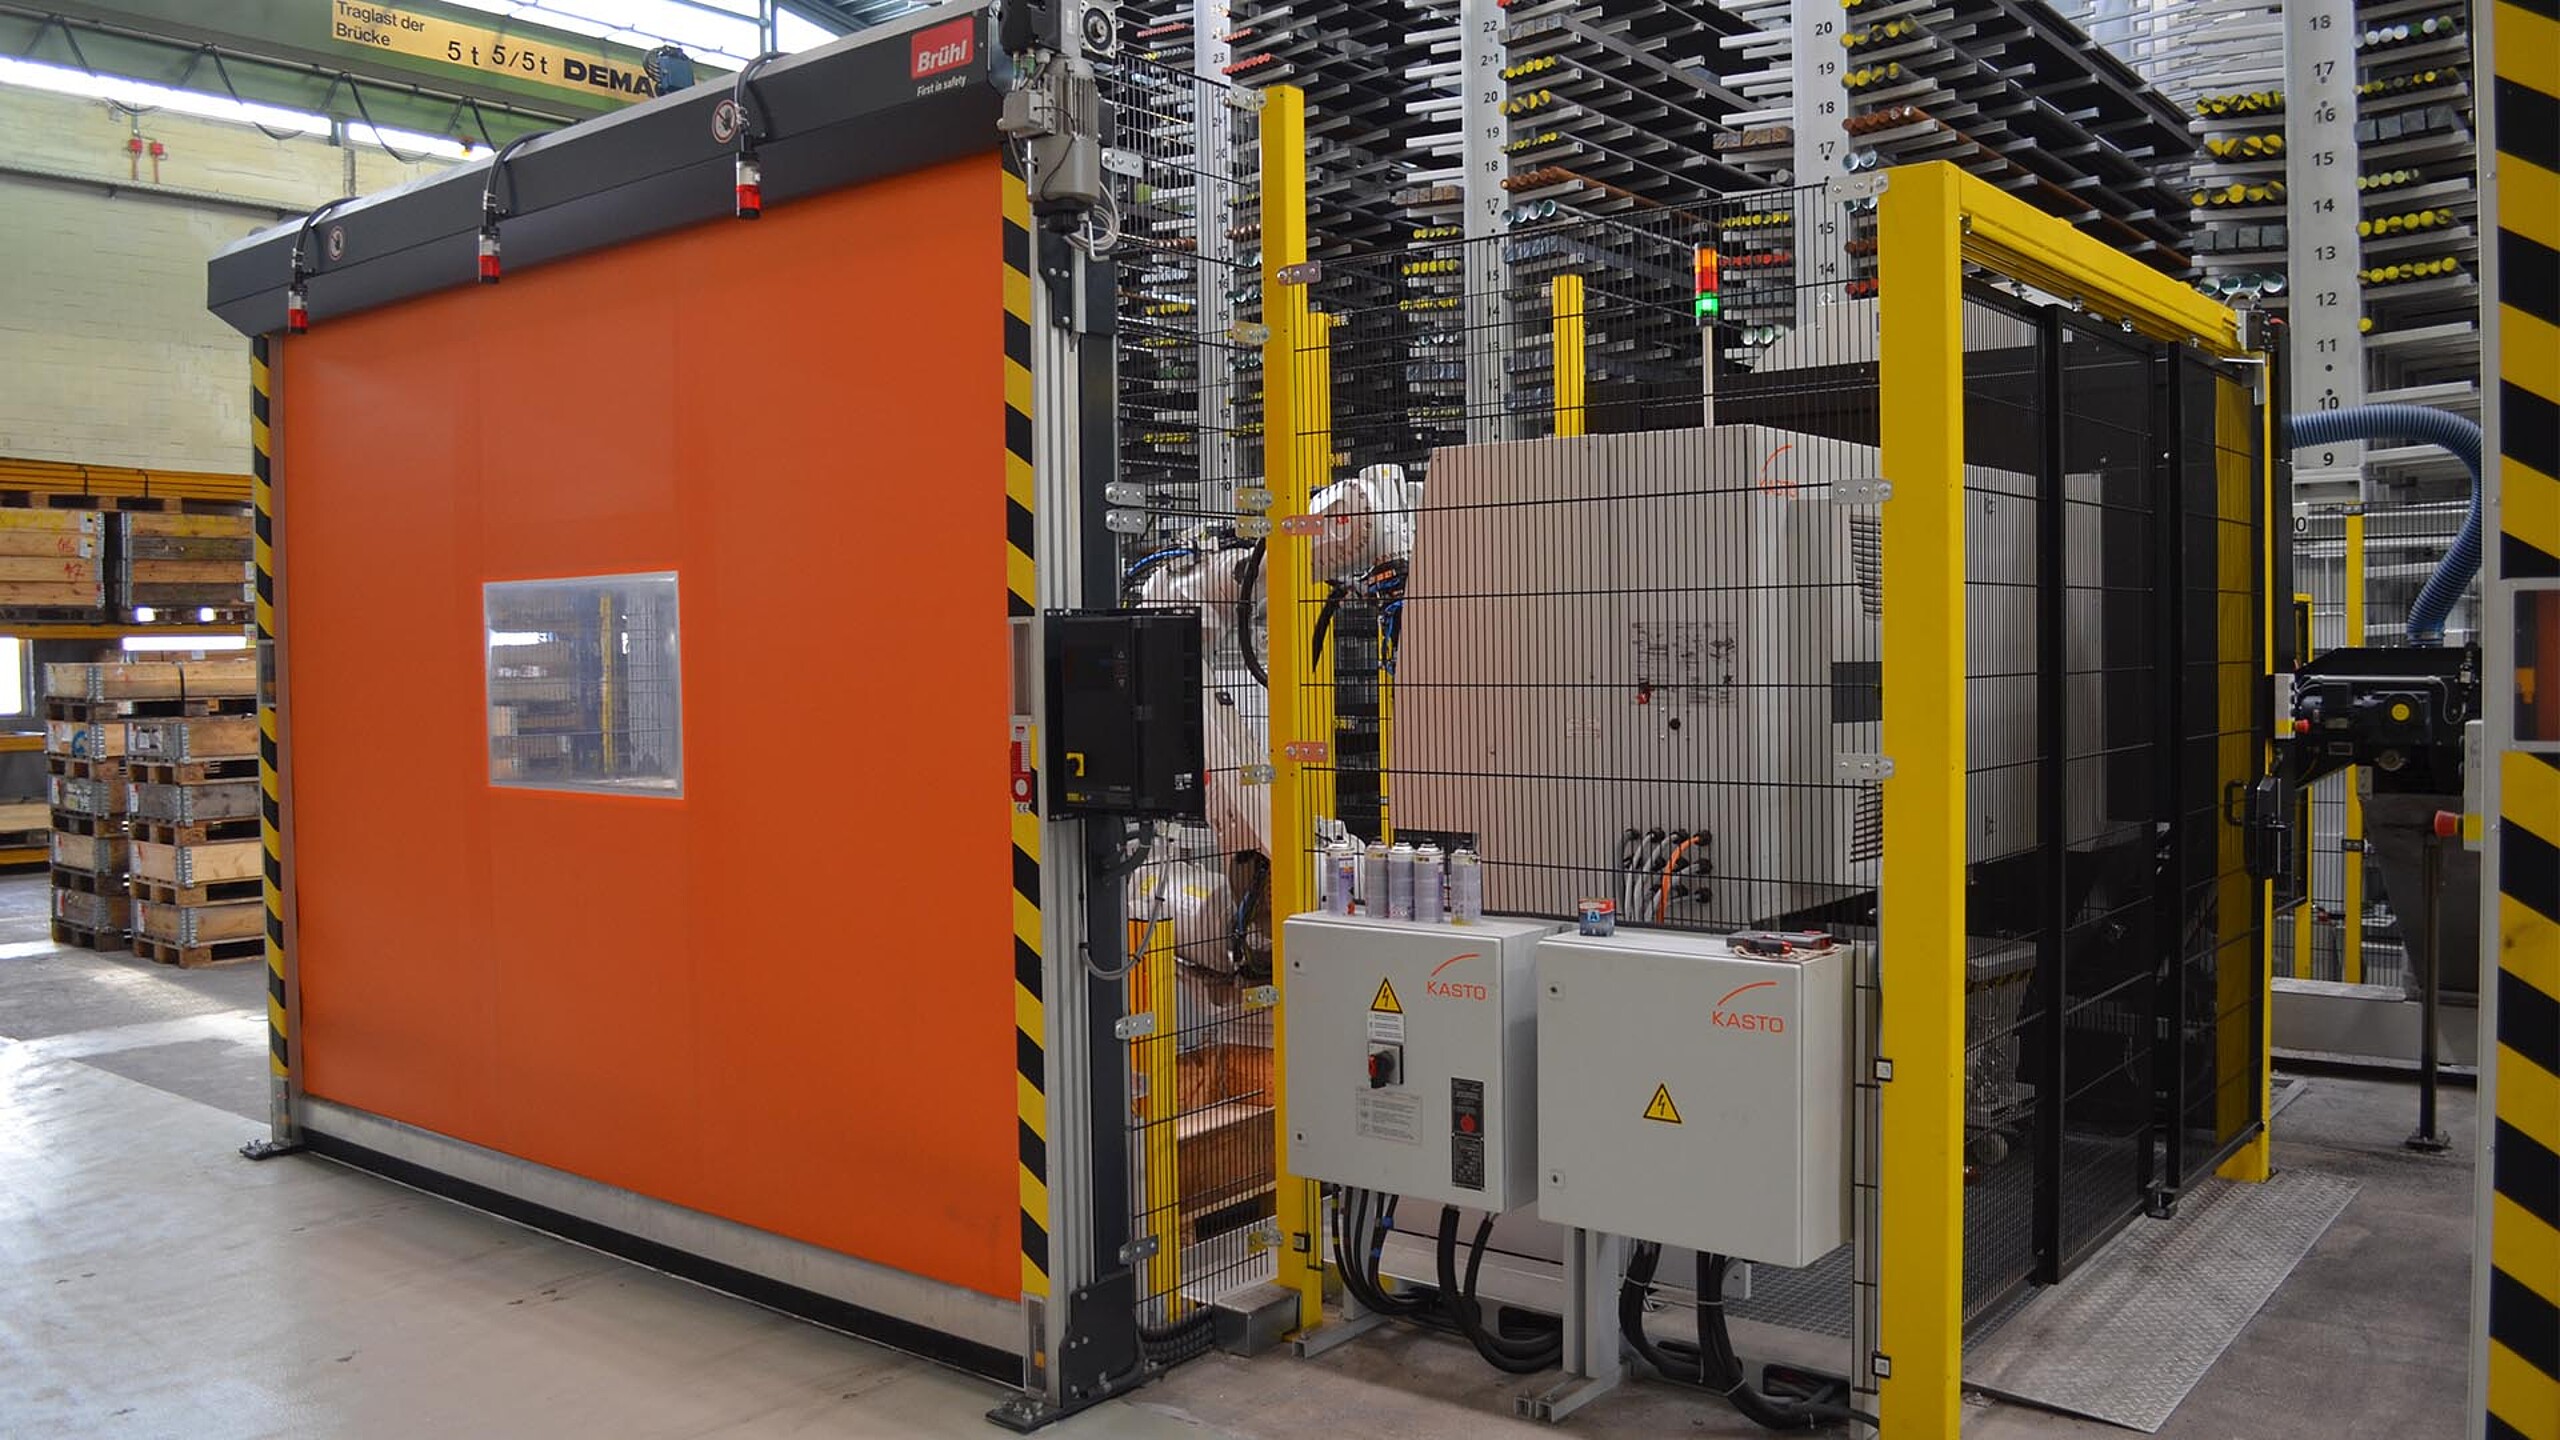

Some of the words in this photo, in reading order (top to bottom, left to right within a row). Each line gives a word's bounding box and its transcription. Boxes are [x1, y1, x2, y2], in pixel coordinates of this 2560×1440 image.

[337, 0, 398, 27] Traglast
[401, 16, 425, 32] der
[2309, 15, 2331, 31] 18
[336, 22, 390, 46] Brücke
[1483, 20, 1497, 33] 22
[1815, 23, 1833, 36] 20
[448, 41, 461, 61] 5
[471, 46, 480, 66] t
[539, 56, 548, 75] t
[917, 40, 968, 73] Brühl
[1817, 62, 1835, 76] 19
[2314, 61, 2335, 77] 17
[563, 58, 661, 98] DEMA
[917, 83, 934, 97] First
[935, 80, 942, 92] in
[943, 75, 968, 88] safety
[1483, 91, 1498, 103] 20
[1817, 101, 1835, 115] 18
[2314, 107, 2336, 123] 16
[1486, 126, 1500, 139] 19
[1818, 142, 1835, 156] 17
[1485, 160, 1498, 173] 18
[2312, 152, 2334, 167] 15
[1486, 197, 1500, 210] 17
[2313, 198, 2335, 214] 14
[1818, 222, 1835, 235] 15
[2314, 246, 2337, 261] 13
[1818, 262, 1836, 276] 14
[2315, 293, 2338, 308] 12
[2316, 338, 2338, 353] 11
[2318, 396, 2340, 411] 10
[2323, 452, 2334, 467] 9
[1426, 980, 1488, 1001] KASTO
[1711, 1010, 1786, 1034] KASTO
